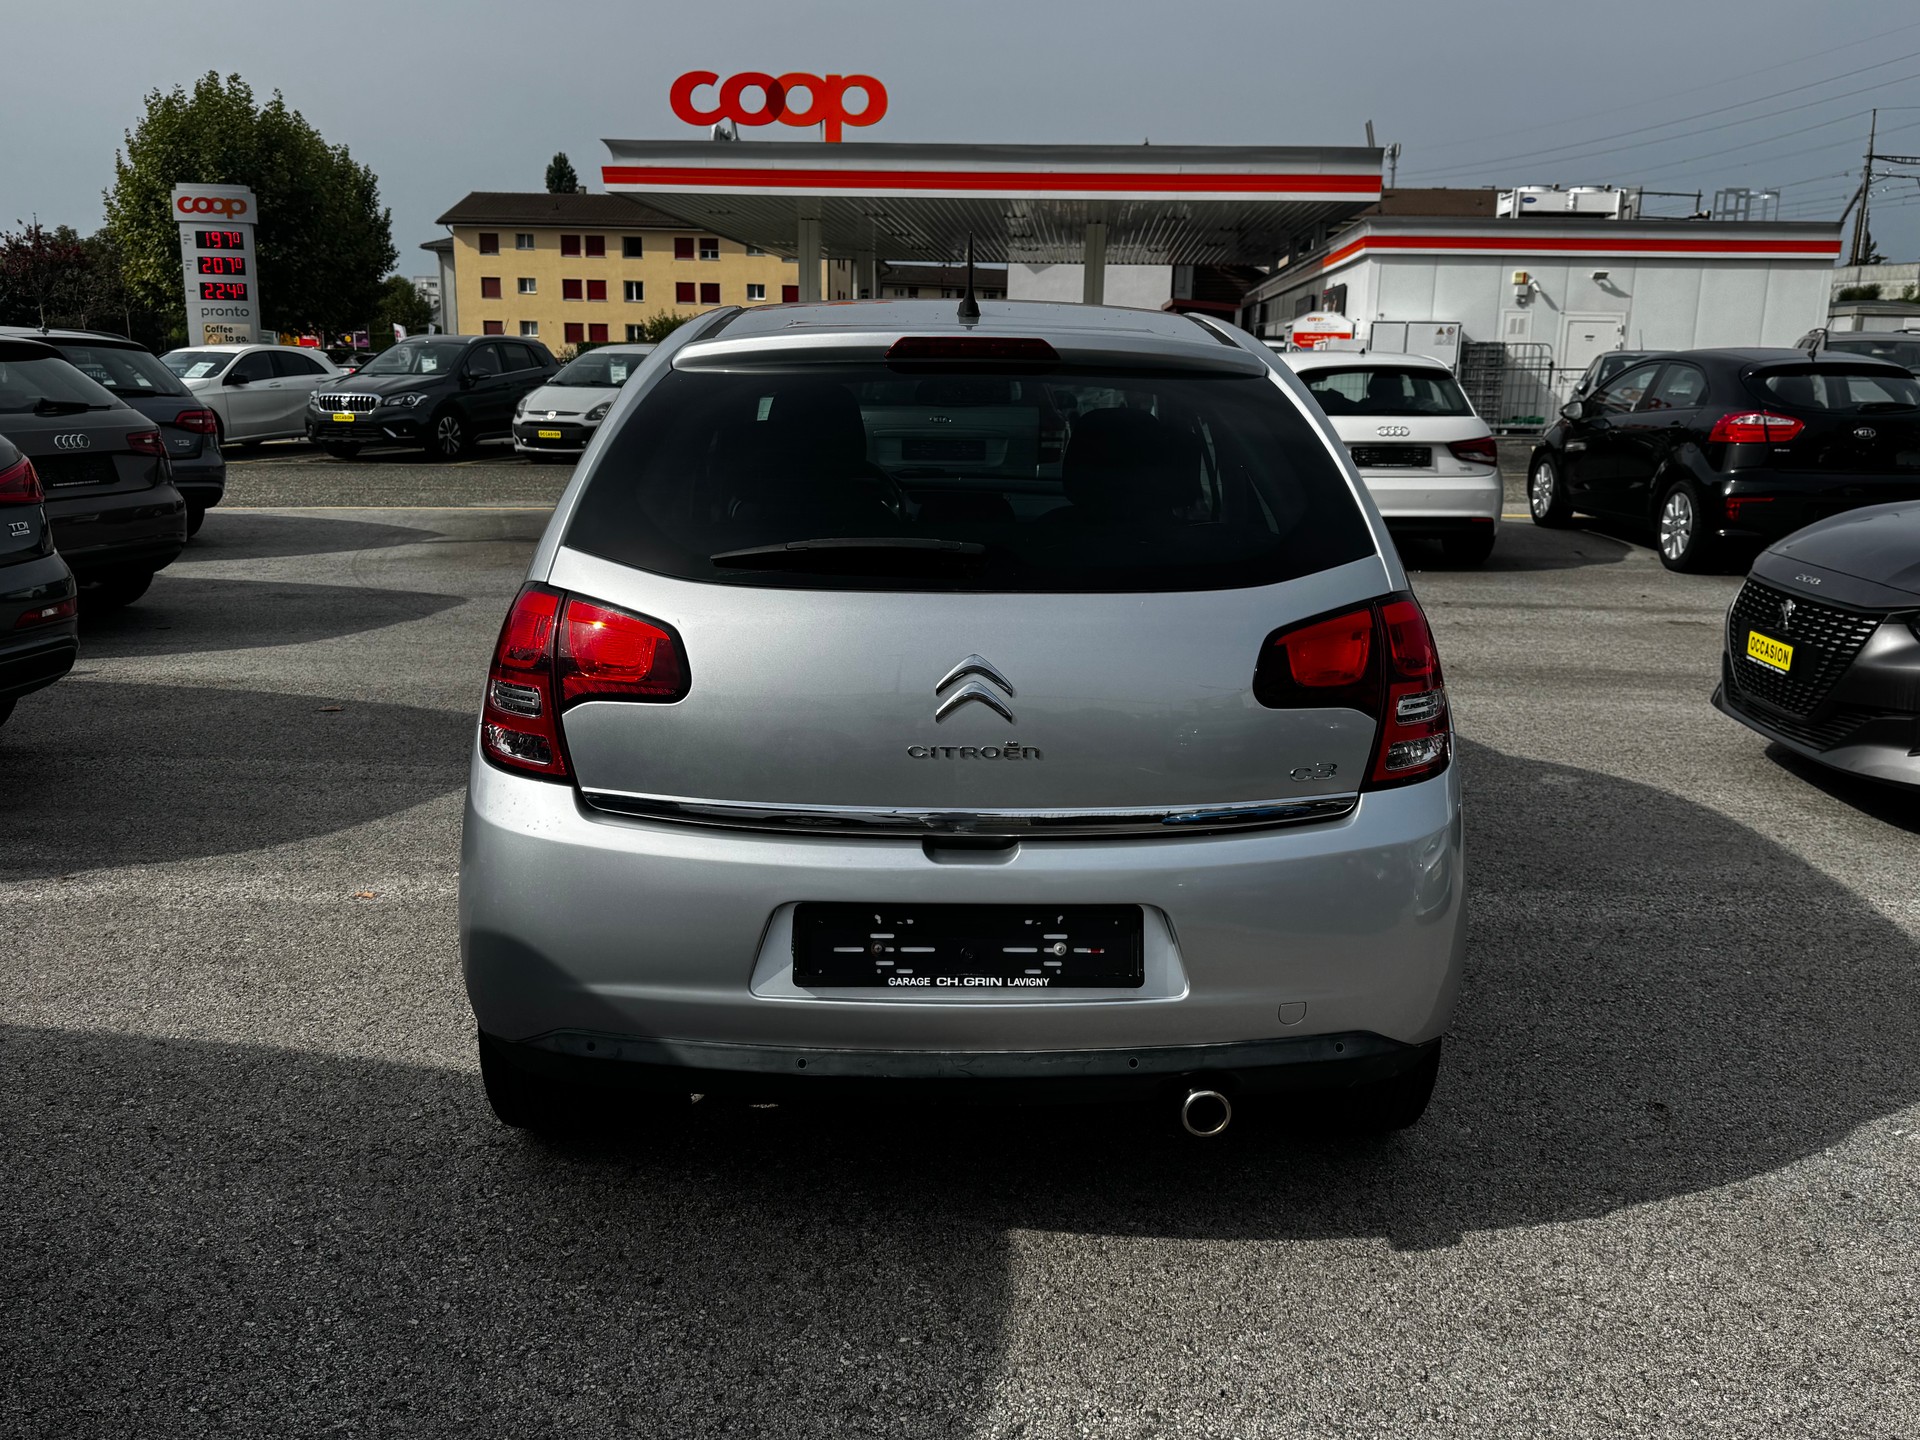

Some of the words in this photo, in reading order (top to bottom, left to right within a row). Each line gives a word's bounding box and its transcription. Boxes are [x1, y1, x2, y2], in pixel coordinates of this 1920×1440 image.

[670, 70, 888, 144] coop
[177, 196, 247, 219] coop
[201, 306, 249, 318] pronto
[205, 325, 233, 333] Coffee
[8, 521, 29, 532] TDI
[1750, 636, 1790, 665] OCCASION
[1290, 763, 1338, 782] C3
[888, 977, 931, 986] GARAGE
[936, 977, 1003, 986] CH.GRIN
[1007, 977, 1050, 986] LAVIGNY
